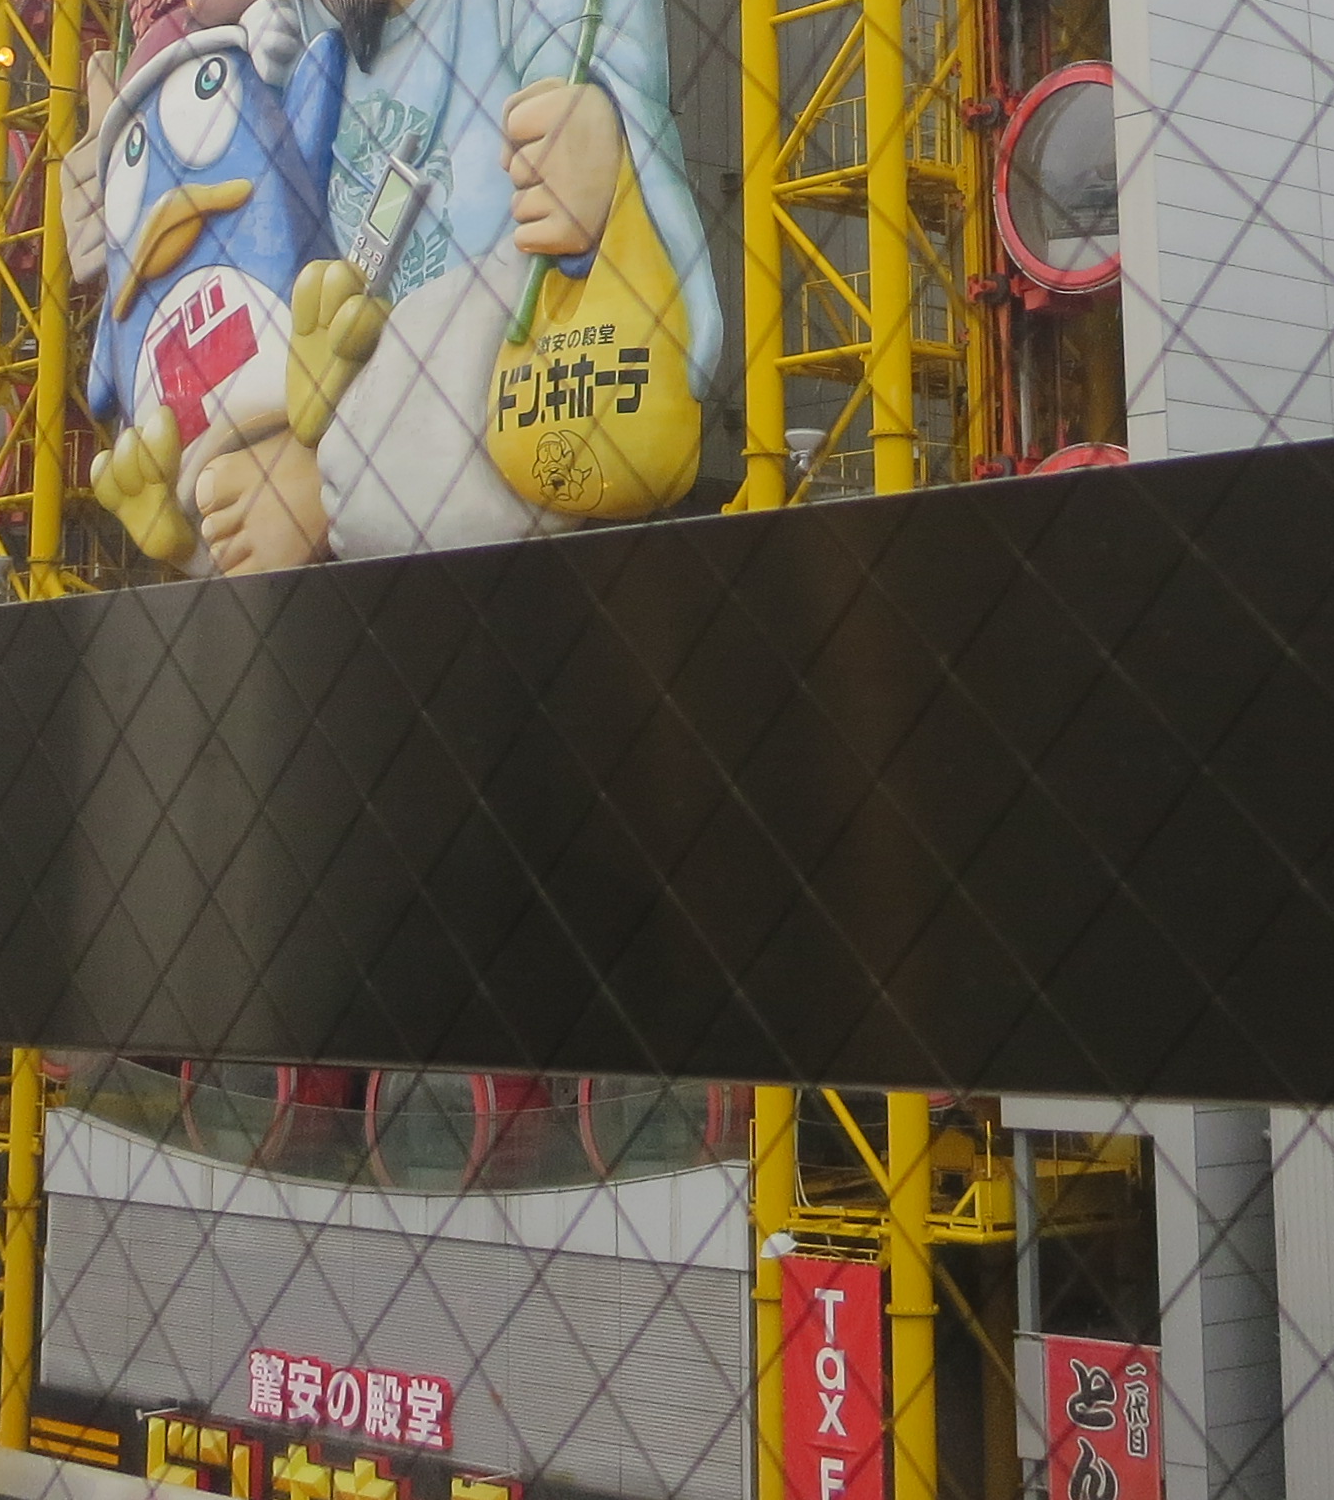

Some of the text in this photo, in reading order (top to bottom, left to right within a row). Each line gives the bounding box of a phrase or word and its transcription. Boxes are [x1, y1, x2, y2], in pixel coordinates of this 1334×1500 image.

[250, 1351, 443, 1447] 驚安の殿堂
